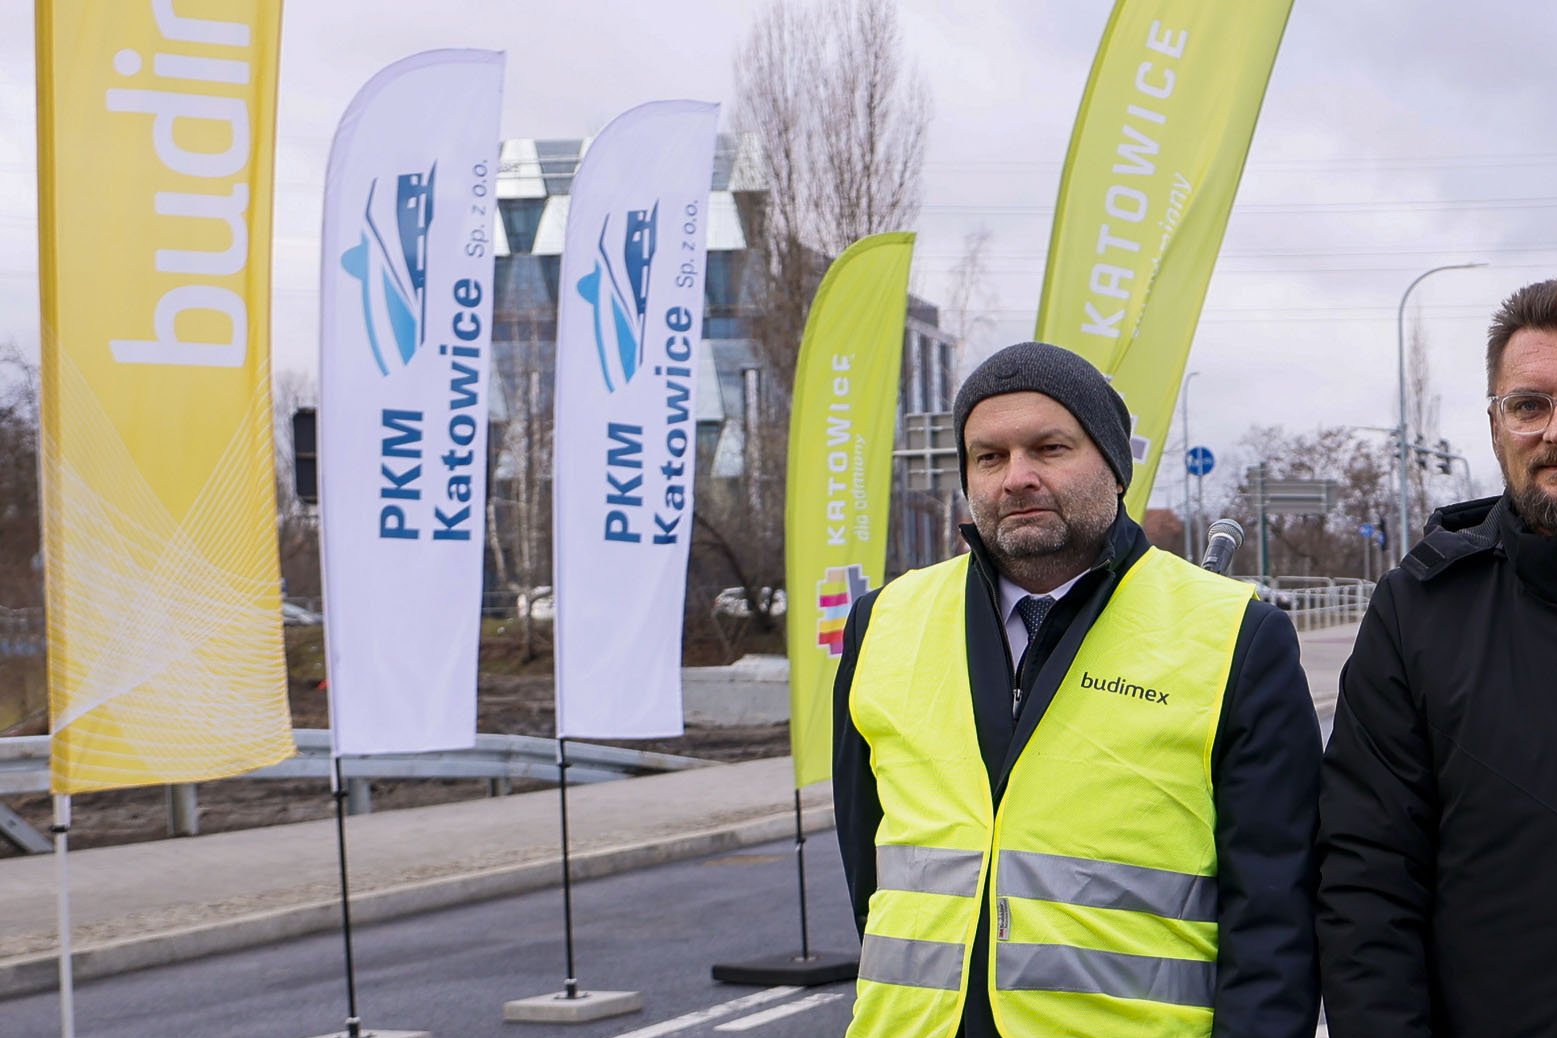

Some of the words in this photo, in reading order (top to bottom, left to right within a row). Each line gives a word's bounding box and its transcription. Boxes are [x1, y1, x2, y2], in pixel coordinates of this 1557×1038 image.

[472, 158, 489, 199] o.o.
[1081, 20, 1189, 339] KATOWICE
[471, 205, 486, 221] z
[683, 199, 699, 234] o.o.
[465, 225, 485, 258] Sp.
[682, 238, 695, 252] z
[675, 258, 695, 289] Sp.
[433, 278, 482, 541] Katowice
[652, 306, 693, 545] Katowice
[379, 408, 424, 540] PKM
[604, 422, 644, 544] PKM
[1081, 671, 1169, 705] budimex
